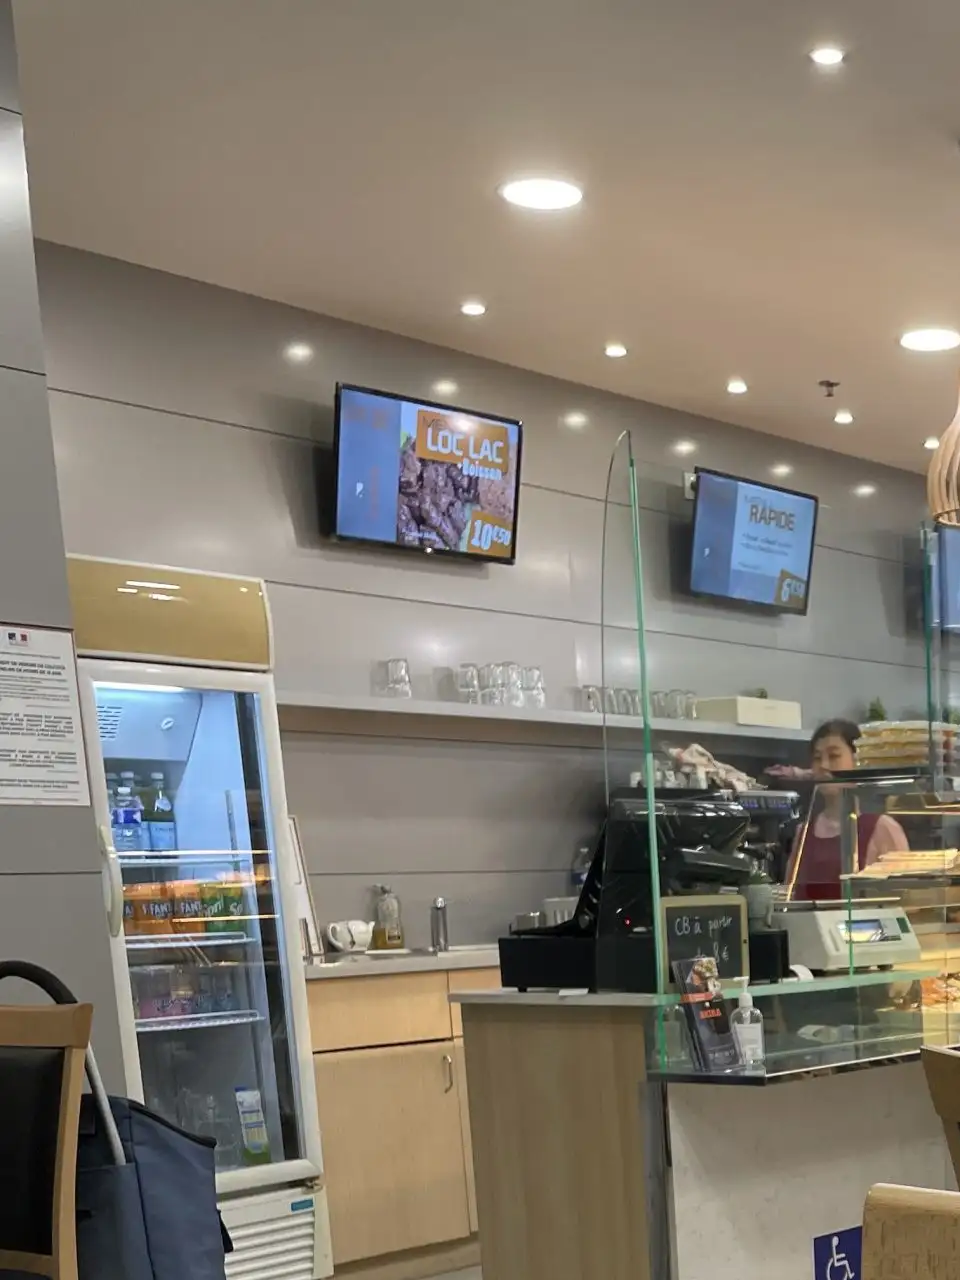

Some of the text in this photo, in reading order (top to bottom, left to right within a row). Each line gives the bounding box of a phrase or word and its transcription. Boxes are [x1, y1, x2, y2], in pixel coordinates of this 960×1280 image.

[427, 426, 504, 463] LOC LAC
[750, 504, 795, 531] RAPIDE
[675, 916, 691, 936] CB
[708, 915, 733, 938] partir
